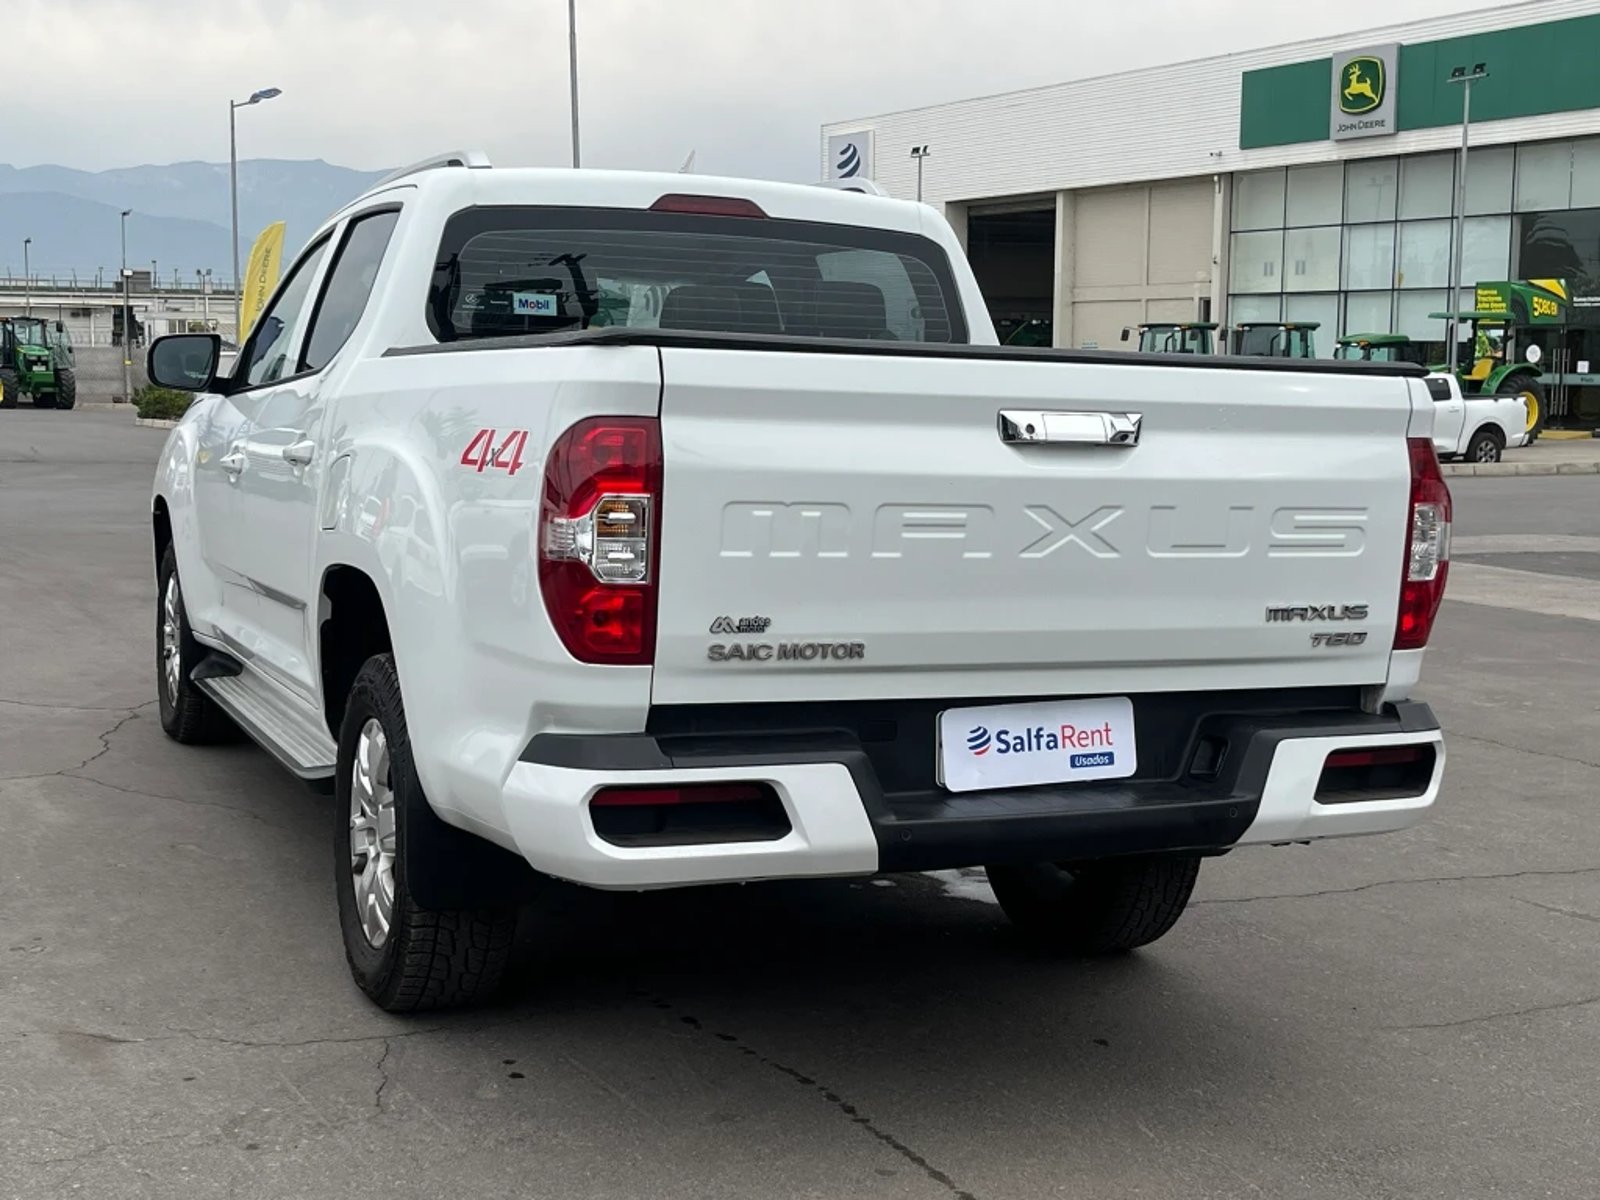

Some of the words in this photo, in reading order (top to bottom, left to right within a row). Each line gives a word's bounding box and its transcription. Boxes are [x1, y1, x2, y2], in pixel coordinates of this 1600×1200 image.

[1337, 122, 1357, 132] JOHN
[1357, 120, 1386, 129] DEERE
[259, 247, 272, 283] DEERE
[518, 298, 550, 310] Mobil
[460, 429, 529, 475] 4x4
[719, 500, 1368, 558] MAXUS
[1265, 604, 1369, 622] MAXUS
[708, 643, 774, 661] SAIC
[777, 642, 865, 660] MOTOR
[996, 722, 1114, 754] SalfaRent
[1074, 753, 1109, 766] Usados
